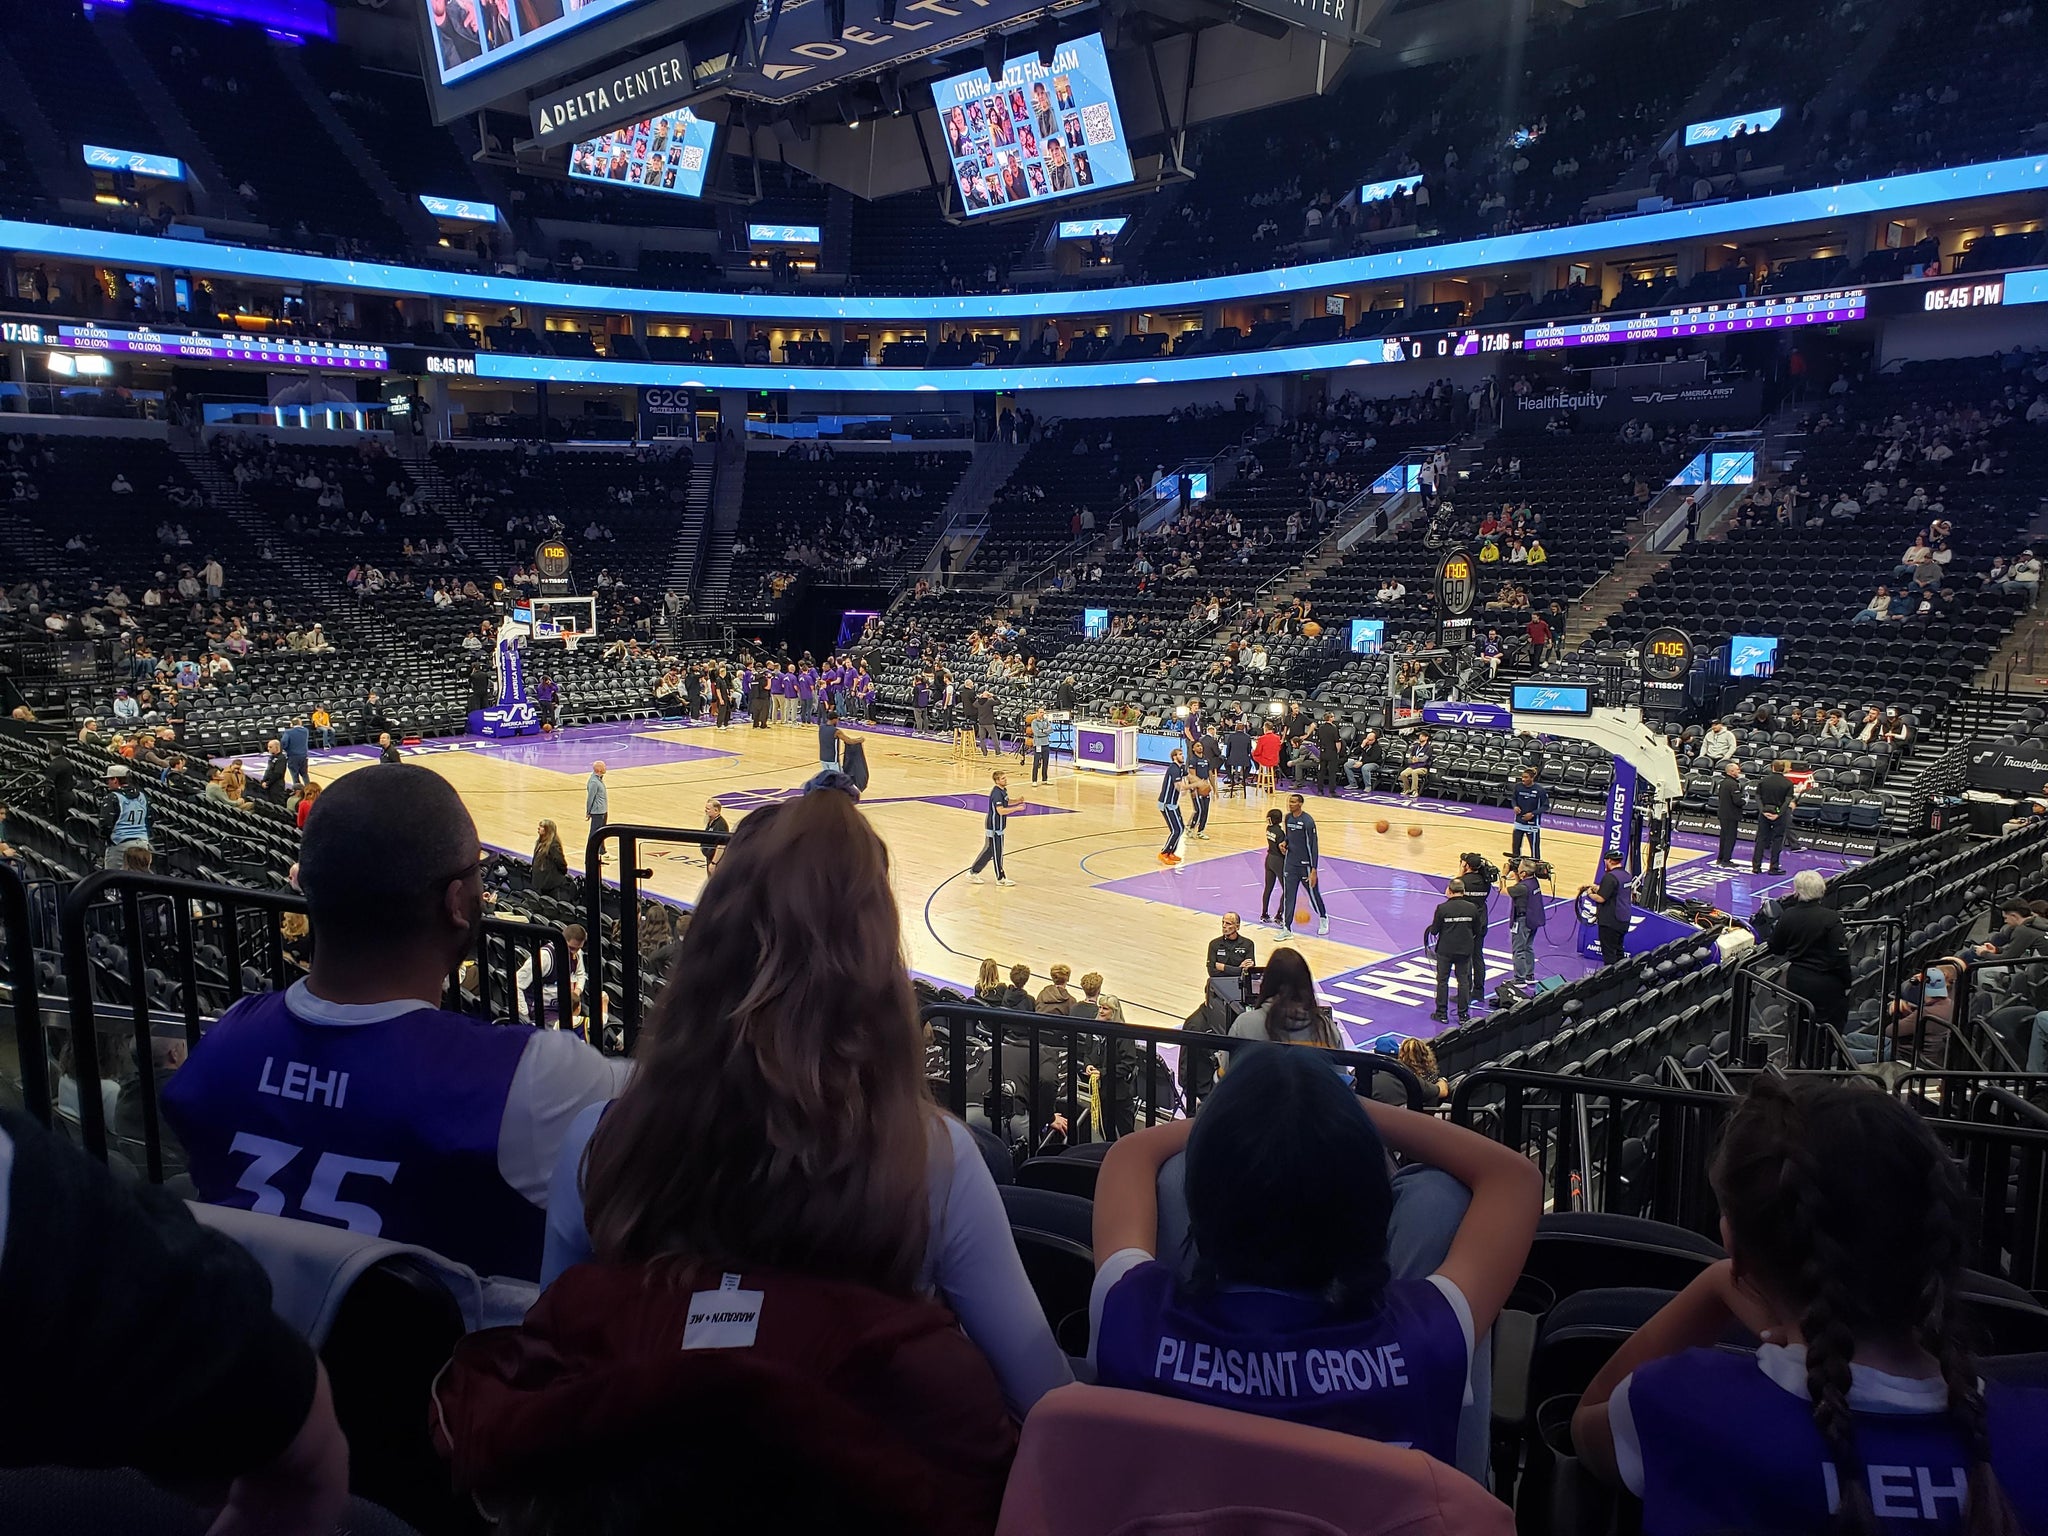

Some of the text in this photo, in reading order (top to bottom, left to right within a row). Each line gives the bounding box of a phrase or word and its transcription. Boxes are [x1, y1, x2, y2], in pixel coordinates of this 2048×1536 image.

[954, 77, 983, 102] UTAH
[1024, 60, 1049, 82] FAN
[1051, 49, 1079, 74] CAM
[555, 58, 683, 125] DELTA CENTER
[1925, 284, 2000, 311] 06:45 PM
[1, 323, 57, 344] 17:06 1ST
[1537, 329, 1549, 337] 0/0
[1550, 328, 1564, 336] (0%)
[1581, 325, 1594, 333] 0/0
[1595, 323, 1610, 332] (0%)
[1628, 320, 1641, 328] 0/0
[1642, 319, 1658, 327] (0%)
[1481, 333, 1523, 351] 17:06 1ST
[1536, 339, 1548, 347] 0/0
[1549, 338, 1563, 346] (0%)
[1594, 334, 1609, 342] (0%)
[1641, 329, 1657, 338] (0%)
[1412, 340, 1447, 357] 0 0
[426, 356, 475, 375] 06:45 PM
[646, 389, 689, 407] G2G
[1518, 392, 1605, 411] HealthEquity
[1680, 388, 1734, 398] AMERICA FIRST
[544, 548, 565, 557] 17:05
[1445, 563, 1467, 579] 17:05
[1654, 642, 1683, 656] 17:05
[512, 671, 520, 700] AMERICA
[1613, 784, 1626, 823] FIRST
[128, 810, 144, 825] 47
[257, 1056, 349, 1109] LEHI
[228, 1131, 400, 1238] 35
[689, 1314, 705, 1325] ME
[711, 1312, 756, 1323] MARALYN
[1154, 1336, 1409, 1397] PLEASANT GROVE
